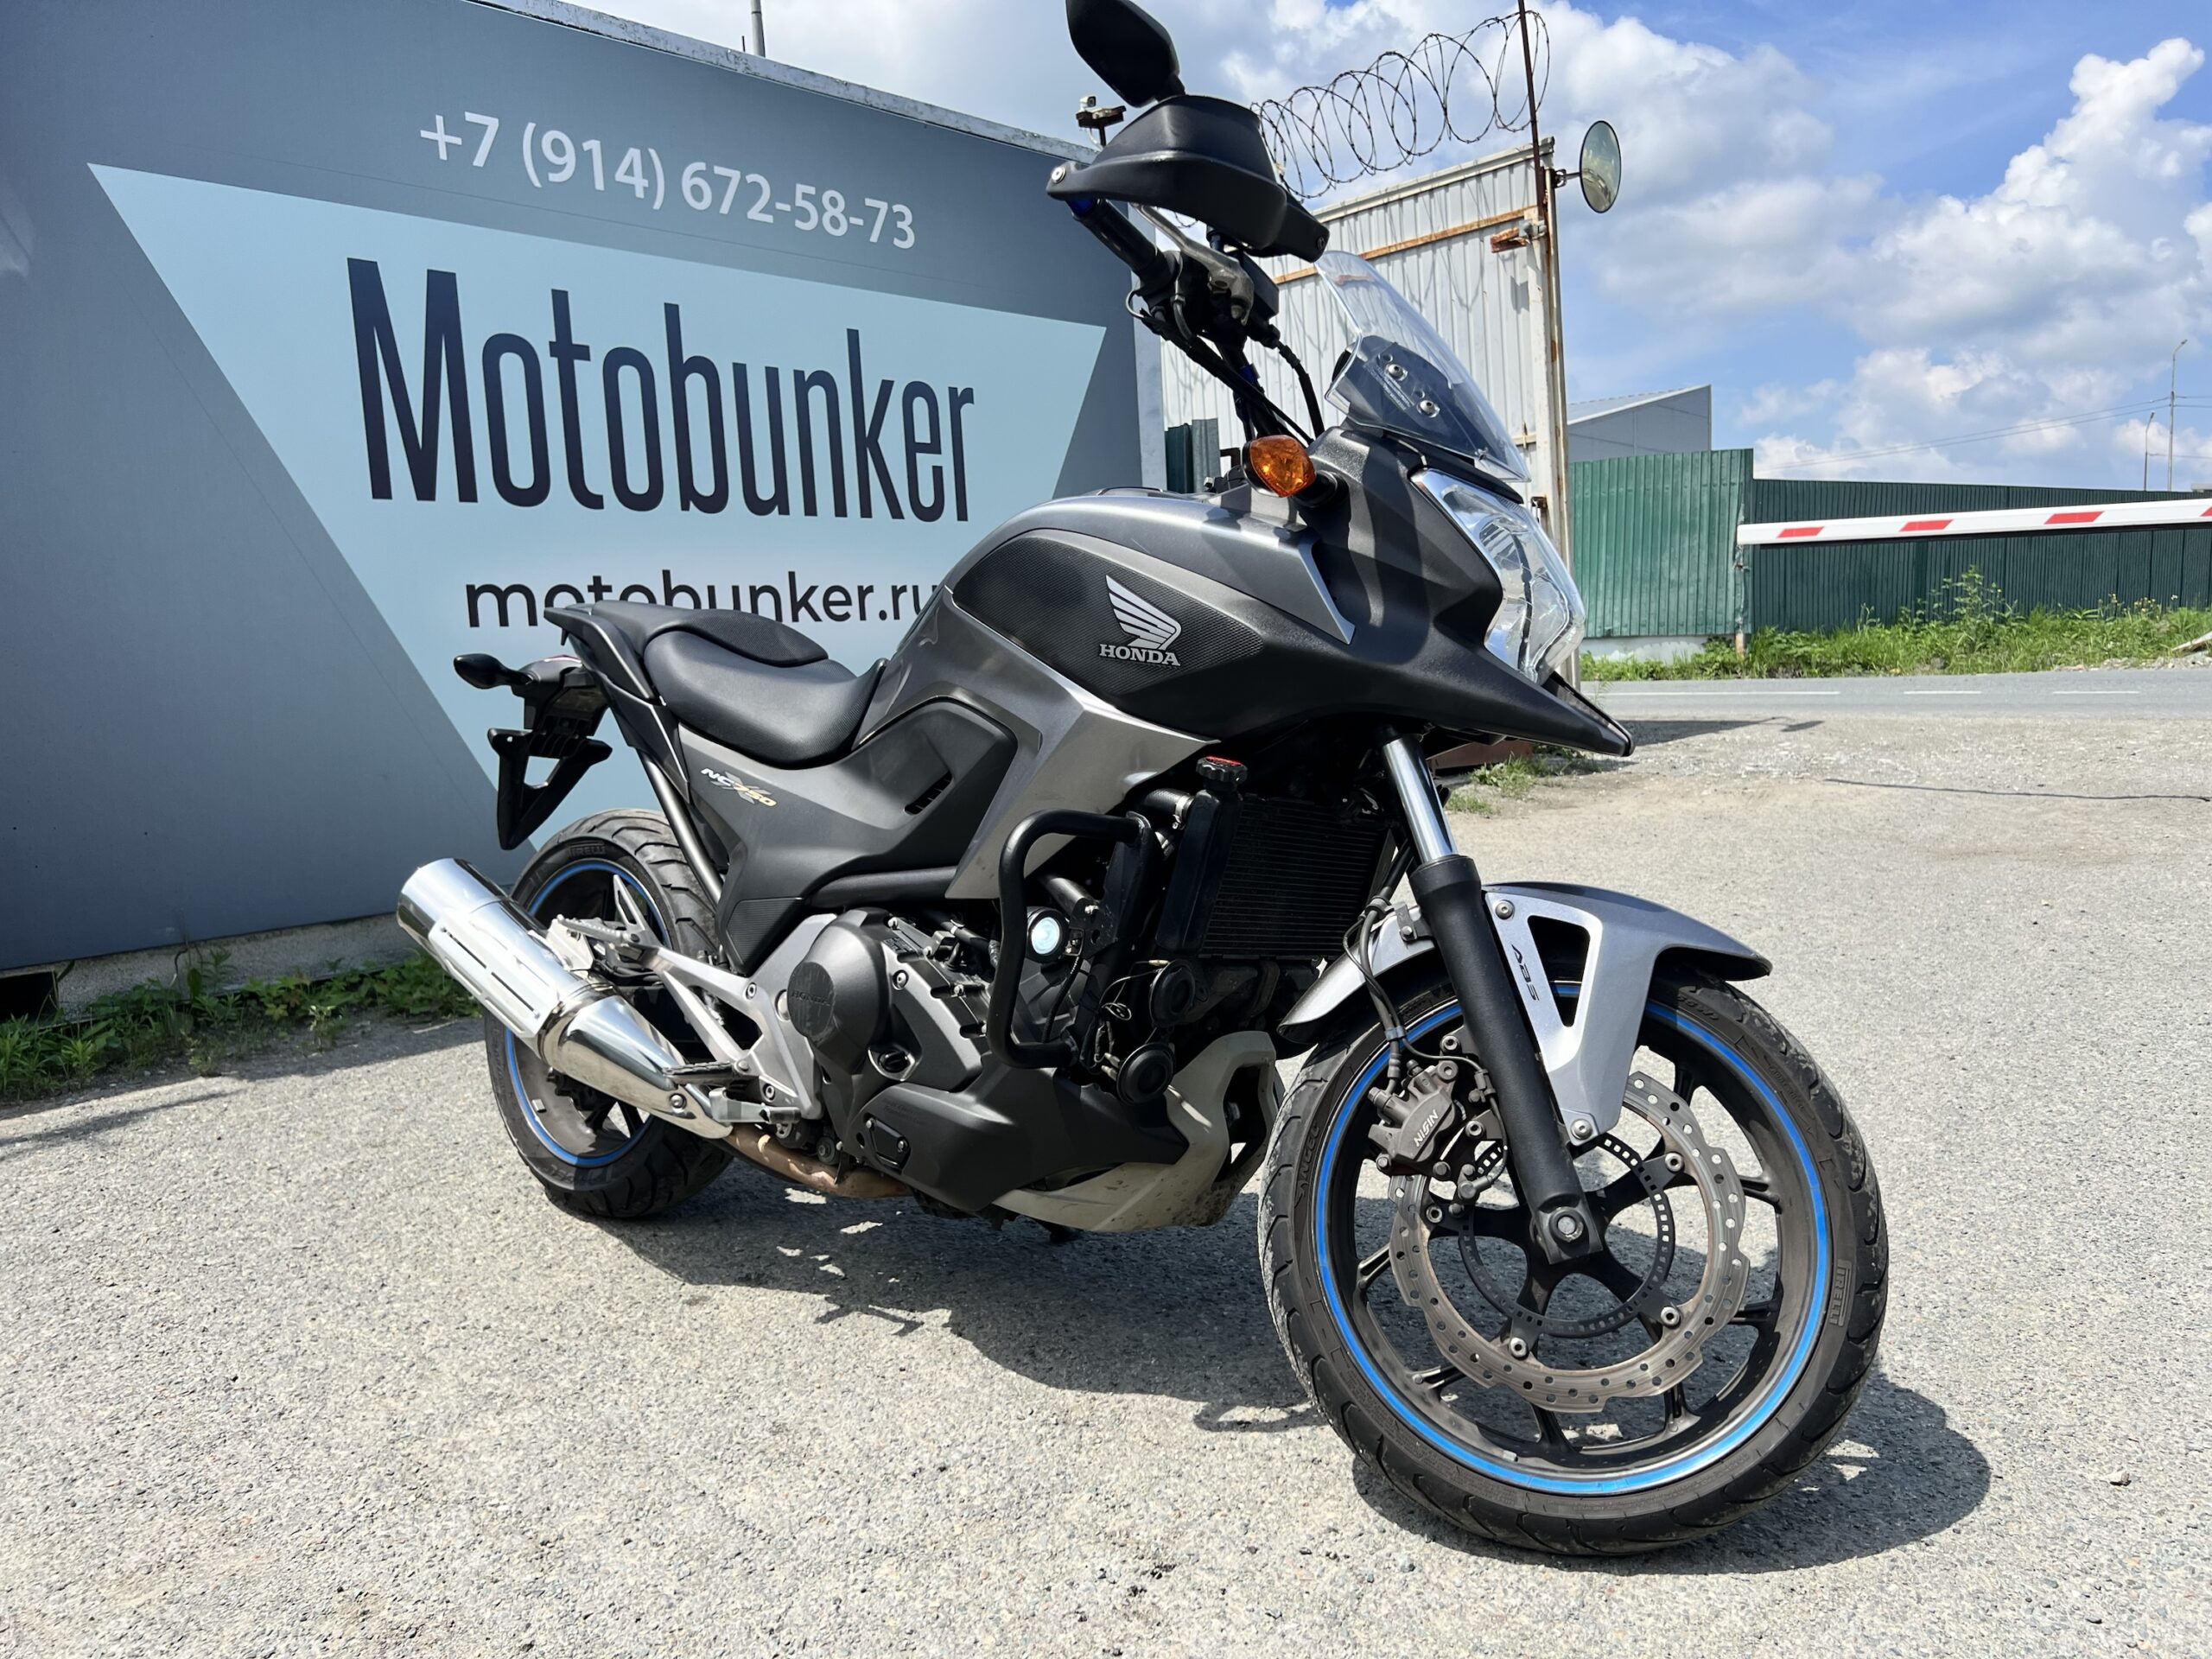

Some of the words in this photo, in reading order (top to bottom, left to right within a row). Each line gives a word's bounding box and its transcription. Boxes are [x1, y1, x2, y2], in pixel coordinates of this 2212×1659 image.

[420, 111, 499, 168] +7
[522, 122, 665, 210] (914)
[681, 161, 916, 250] 672-58-73
[346, 257, 975, 523] Motobunker
[1098, 643, 1181, 667] HONDA
[1510, 944, 1540, 1001] ABS
